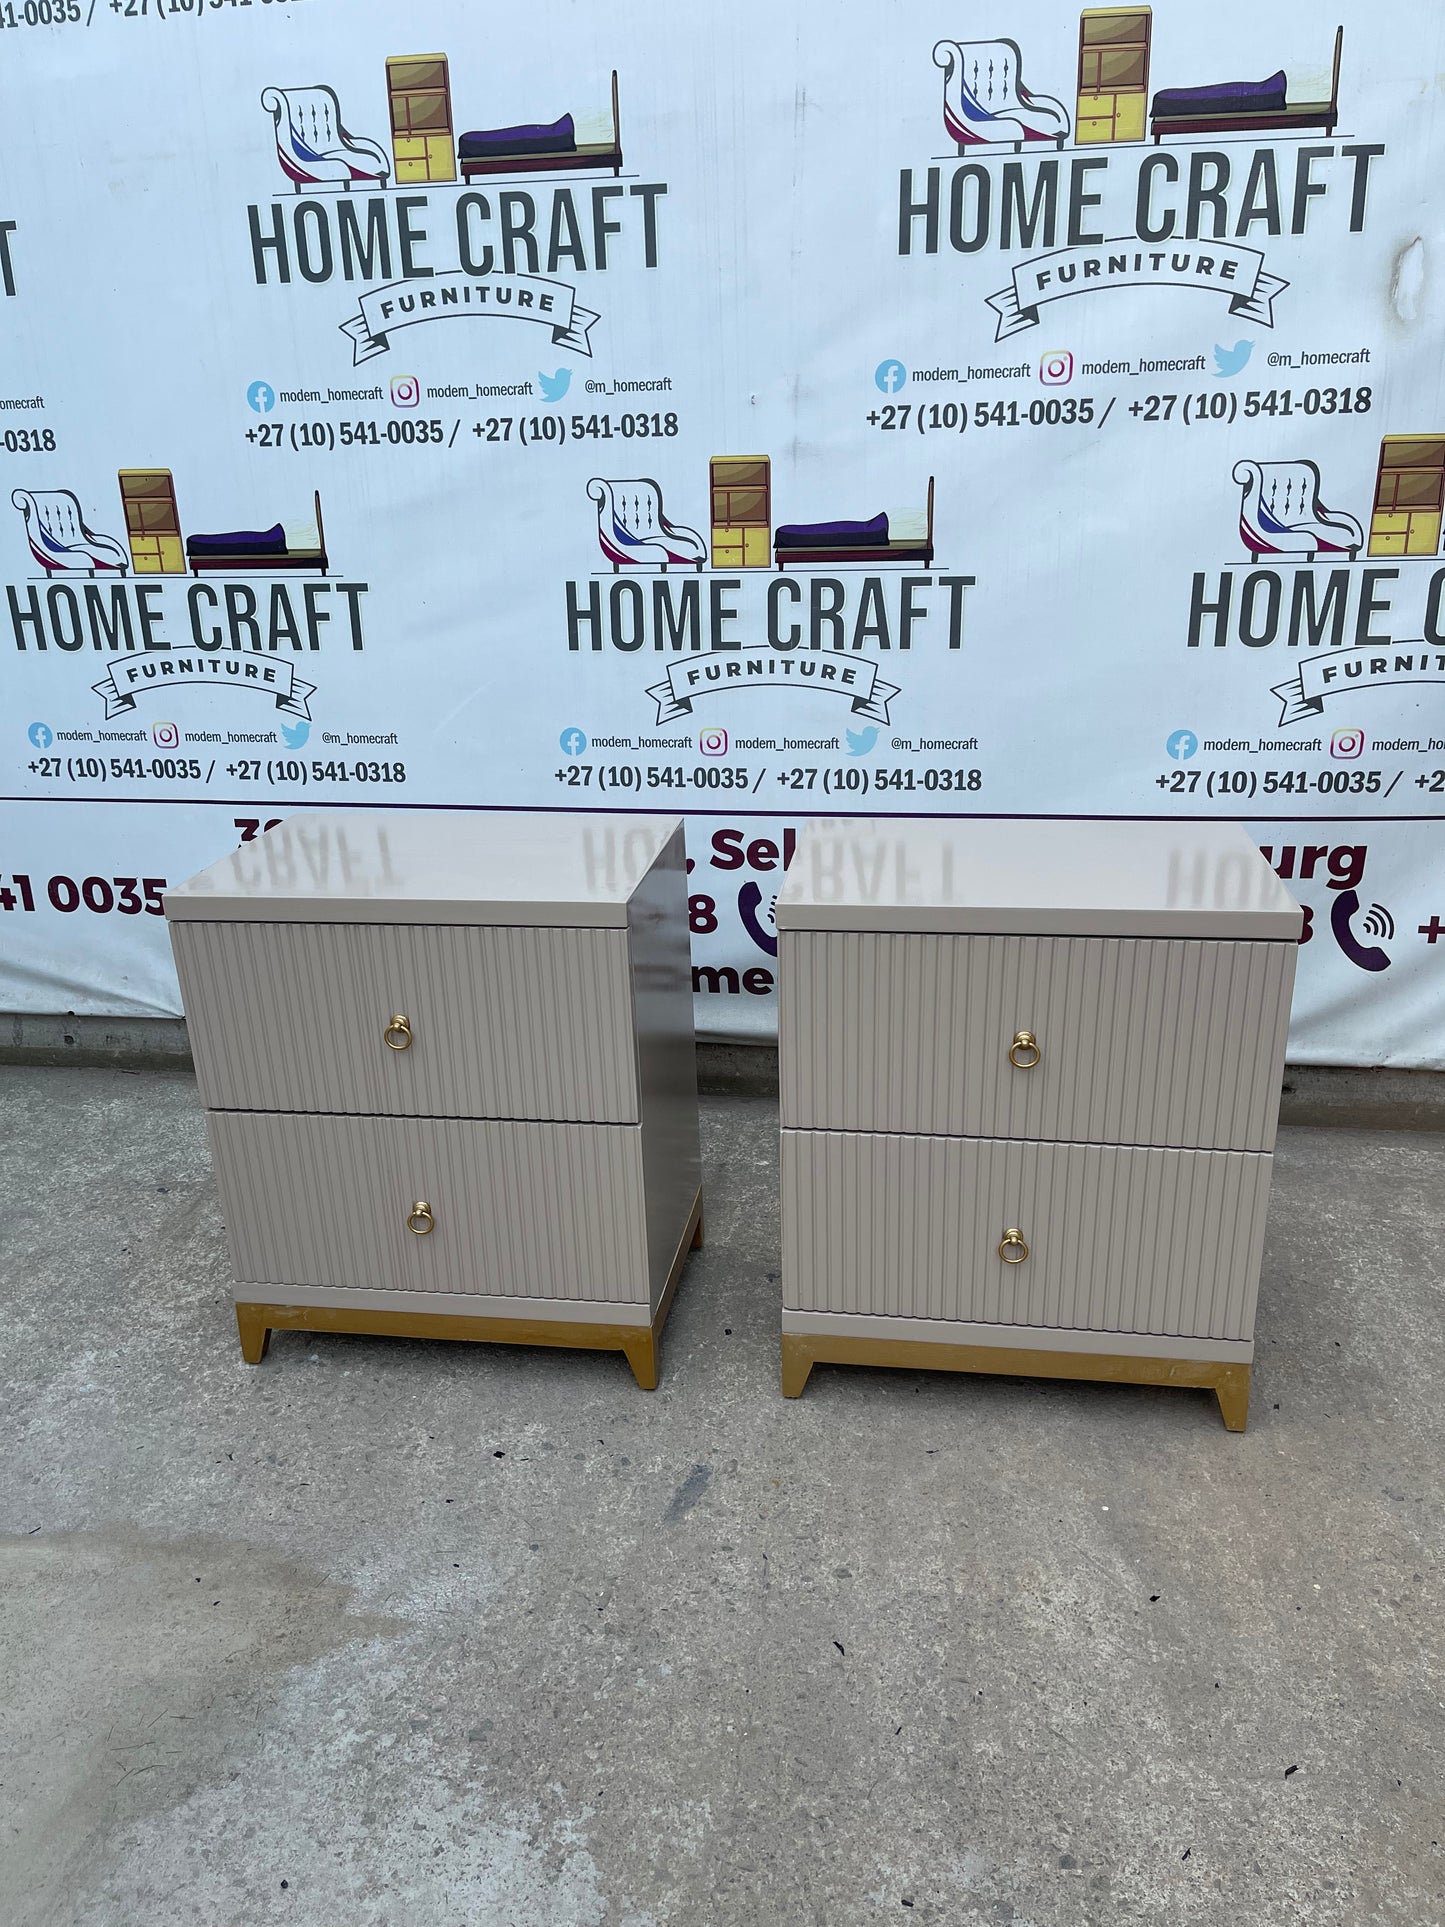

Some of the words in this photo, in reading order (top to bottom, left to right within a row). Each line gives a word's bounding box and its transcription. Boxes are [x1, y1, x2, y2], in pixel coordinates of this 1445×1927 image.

[898, 156, 1109, 256] HOME
[1135, 143, 1386, 243] CRAFT
[247, 192, 435, 285] HOME
[455, 182, 668, 277] CRAFT
[1036, 253, 1239, 291] FURNITURE
[380, 286, 554, 320] FURNITURE
[1267, 347, 1371, 373] @m_homecraft
[584, 376, 673, 396] @m_homecraft
[866, 404, 912, 430] +27
[917, 402, 968, 435] (10)
[973, 398, 1094, 428] 541-0035
[1128, 394, 1178, 422] +27
[1182, 392, 1237, 426] (10)
[1243, 386, 1372, 418] 541-0318
[245, 423, 284, 447] +27
[290, 421, 335, 452] (10)
[339, 419, 444, 446] 541-0035
[472, 417, 513, 442] +27
[519, 414, 566, 447] (10)
[571, 412, 679, 440] 541-0318
[5, 584, 172, 652] HOME
[187, 582, 369, 652] CRAFT
[565, 577, 742, 652] HOME
[767, 575, 976, 652] CRAFT
[1187, 567, 1400, 648] HOME
[126, 658, 276, 683] FURNITURE
[686, 659, 857, 686] FURNITURE
[321, 732, 399, 749] @m_homecraft
[891, 737, 979, 754] @m_homecraft
[1371, 737, 1445, 754] modern_ho
[27, 756, 62, 778] +27
[67, 756, 107, 783] (10)
[110, 757, 201, 780] 541-0035
[225, 760, 262, 781] +27
[266, 759, 308, 786] (10)
[311, 761, 406, 784] 541-0318
[554, 765, 593, 787] +27
[598, 765, 642, 792] (10)
[646, 766, 749, 789] 541-0035
[776, 767, 818, 790] +27
[823, 767, 869, 795] (10)
[874, 768, 982, 792] 541-0318
[1155, 770, 1202, 793] +27
[1206, 770, 1257, 799] (10)
[1262, 770, 1382, 794] 541-0035
